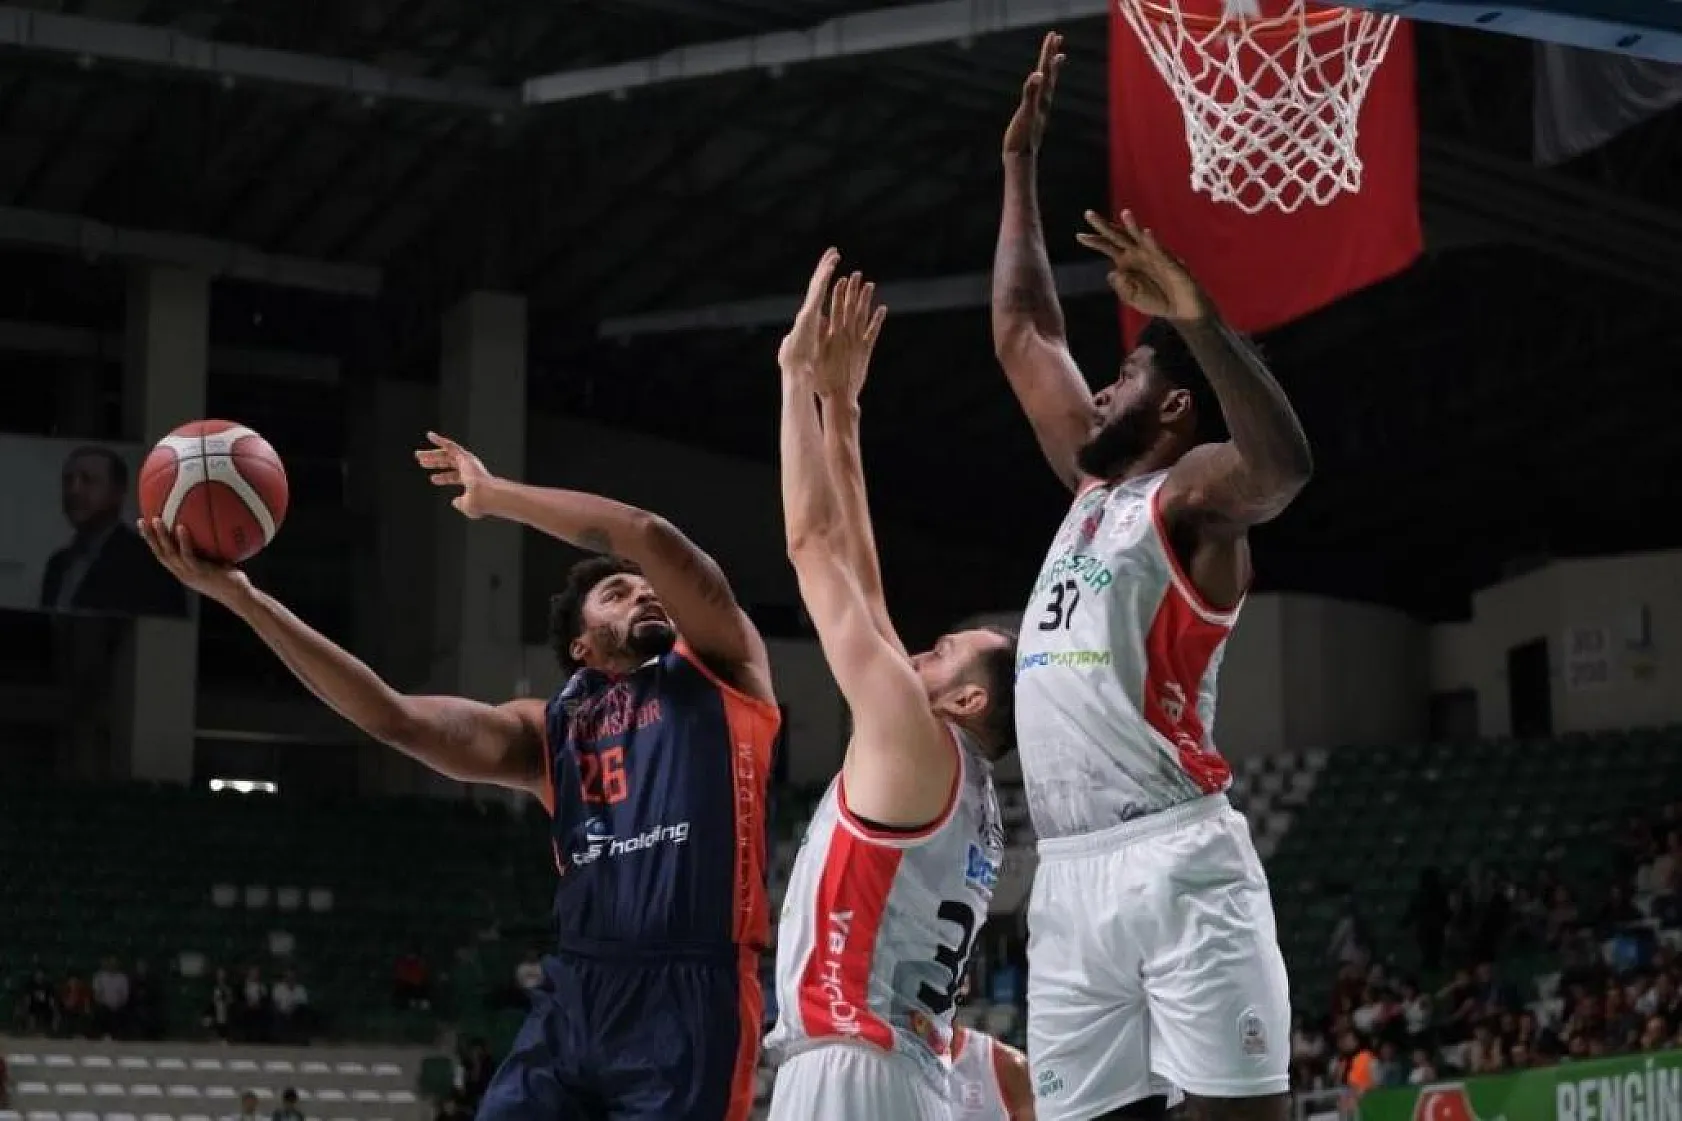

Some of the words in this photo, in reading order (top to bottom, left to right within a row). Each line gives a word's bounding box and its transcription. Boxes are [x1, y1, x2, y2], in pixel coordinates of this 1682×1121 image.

[1039, 579, 1080, 631] 37
[581, 745, 627, 804] 26
[609, 822, 690, 856] holding
